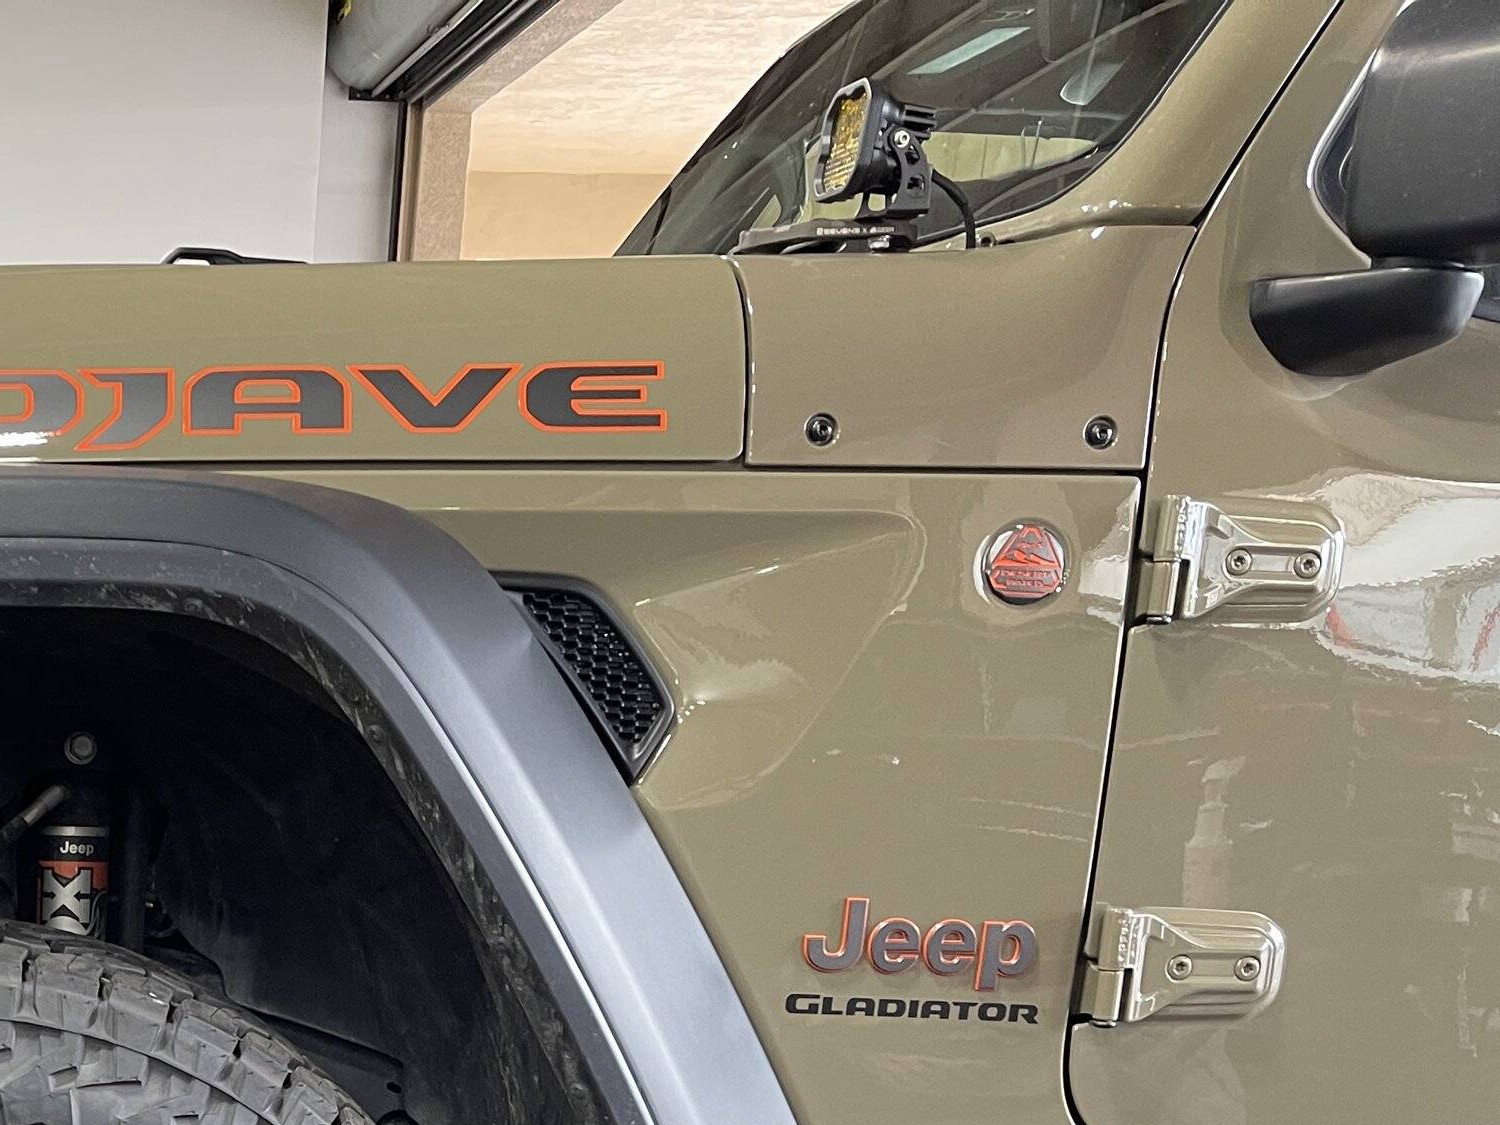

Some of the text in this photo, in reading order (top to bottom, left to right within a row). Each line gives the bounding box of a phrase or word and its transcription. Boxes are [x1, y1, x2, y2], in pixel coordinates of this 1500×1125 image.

[60, 840, 94, 857] Jeep
[803, 896, 1037, 992] Jeep
[785, 993, 1039, 1024] GLADIATOR
